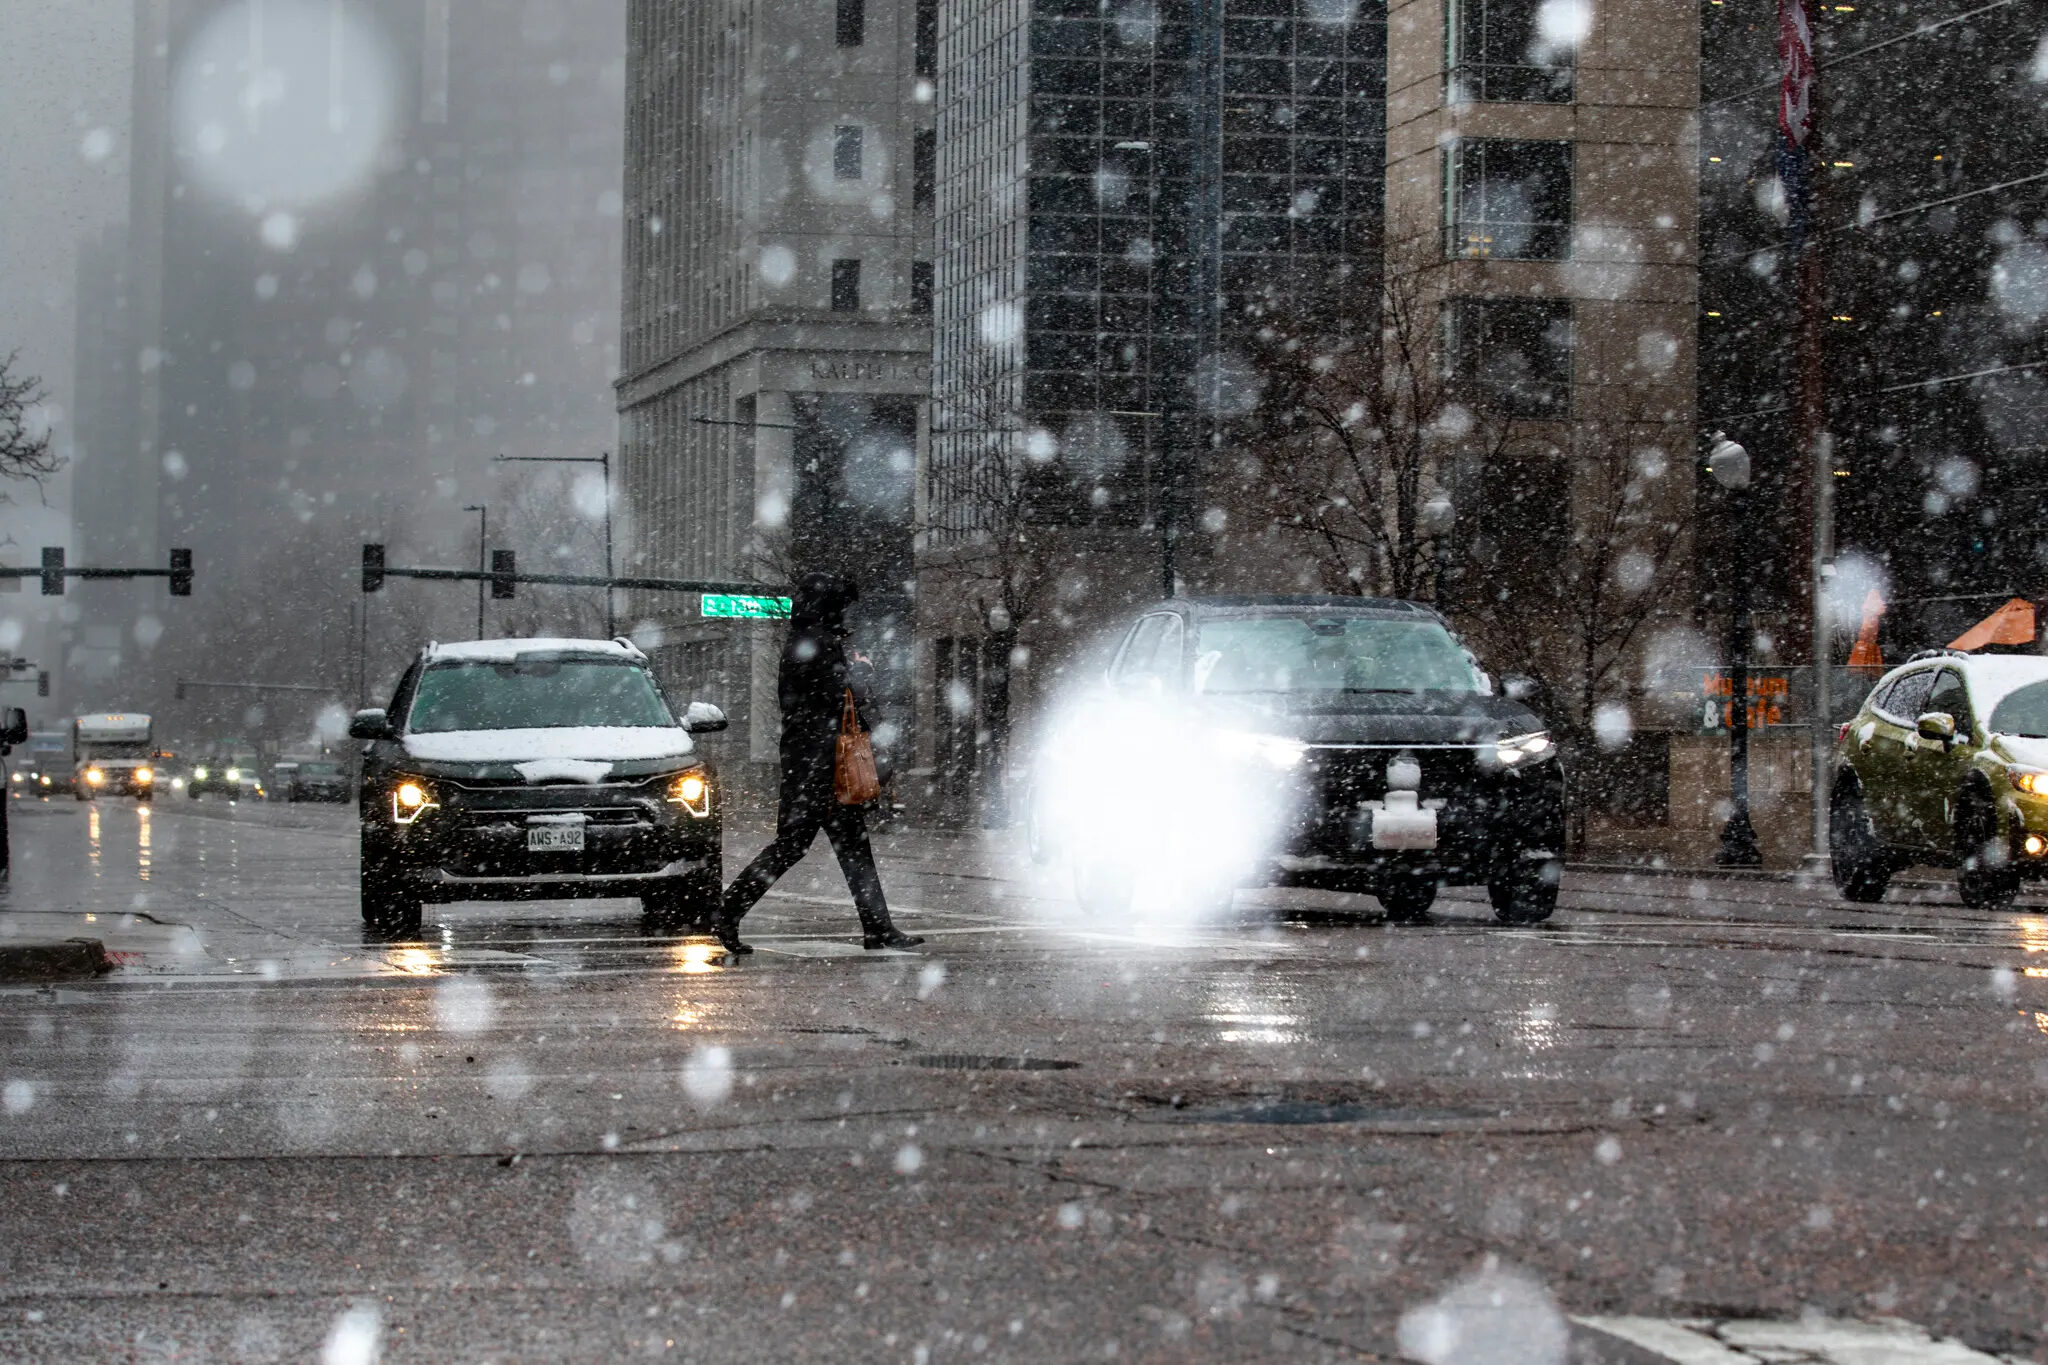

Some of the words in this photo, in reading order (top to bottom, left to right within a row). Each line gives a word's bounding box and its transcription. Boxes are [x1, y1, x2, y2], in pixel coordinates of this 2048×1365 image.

[811, 363, 881, 379] RALPH
[1703, 672, 1788, 697] Mueum
[1703, 700, 1719, 728] &
